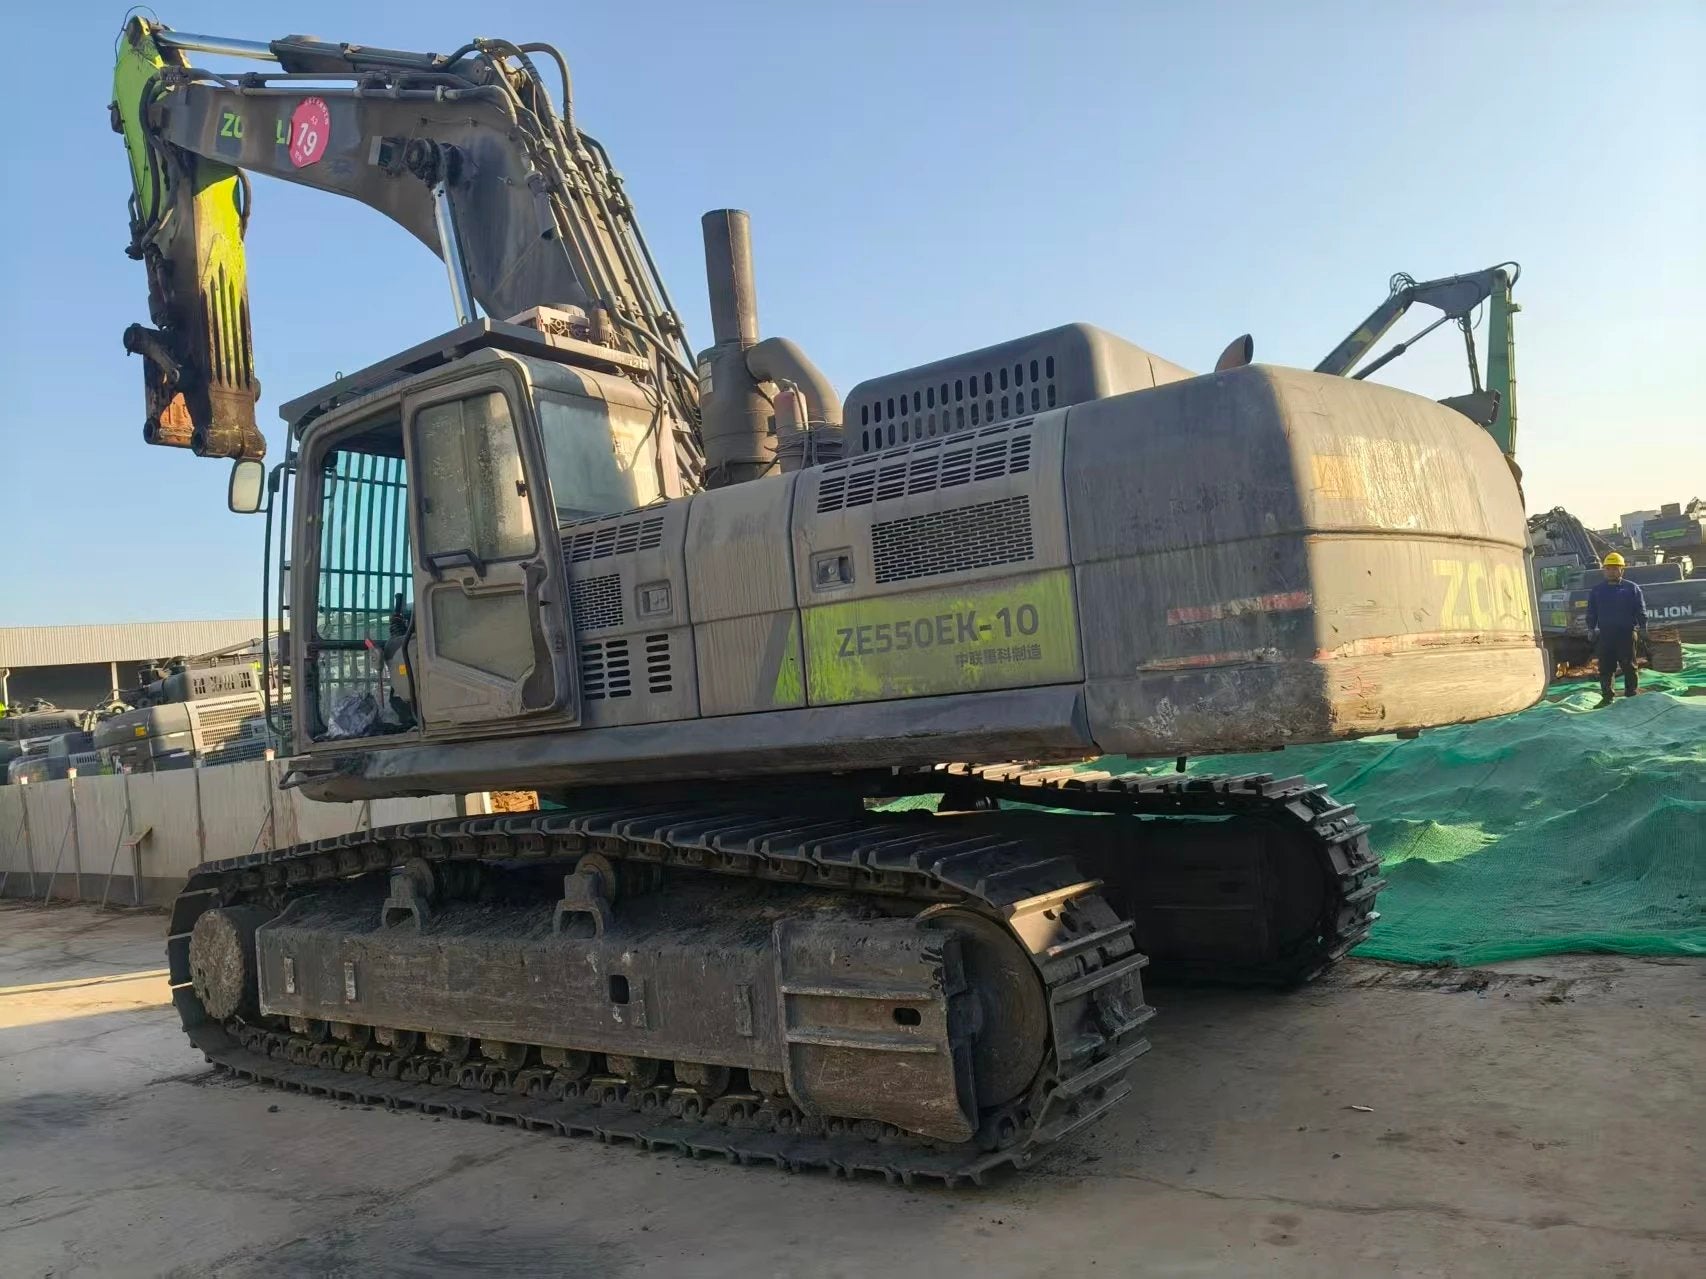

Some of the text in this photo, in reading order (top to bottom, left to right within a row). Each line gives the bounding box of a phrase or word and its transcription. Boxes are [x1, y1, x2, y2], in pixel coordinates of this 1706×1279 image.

[296, 122, 318, 156] 19
[836, 603, 1040, 658] ZE550EK-10
[955, 643, 1042, 666] 中联重科制造
